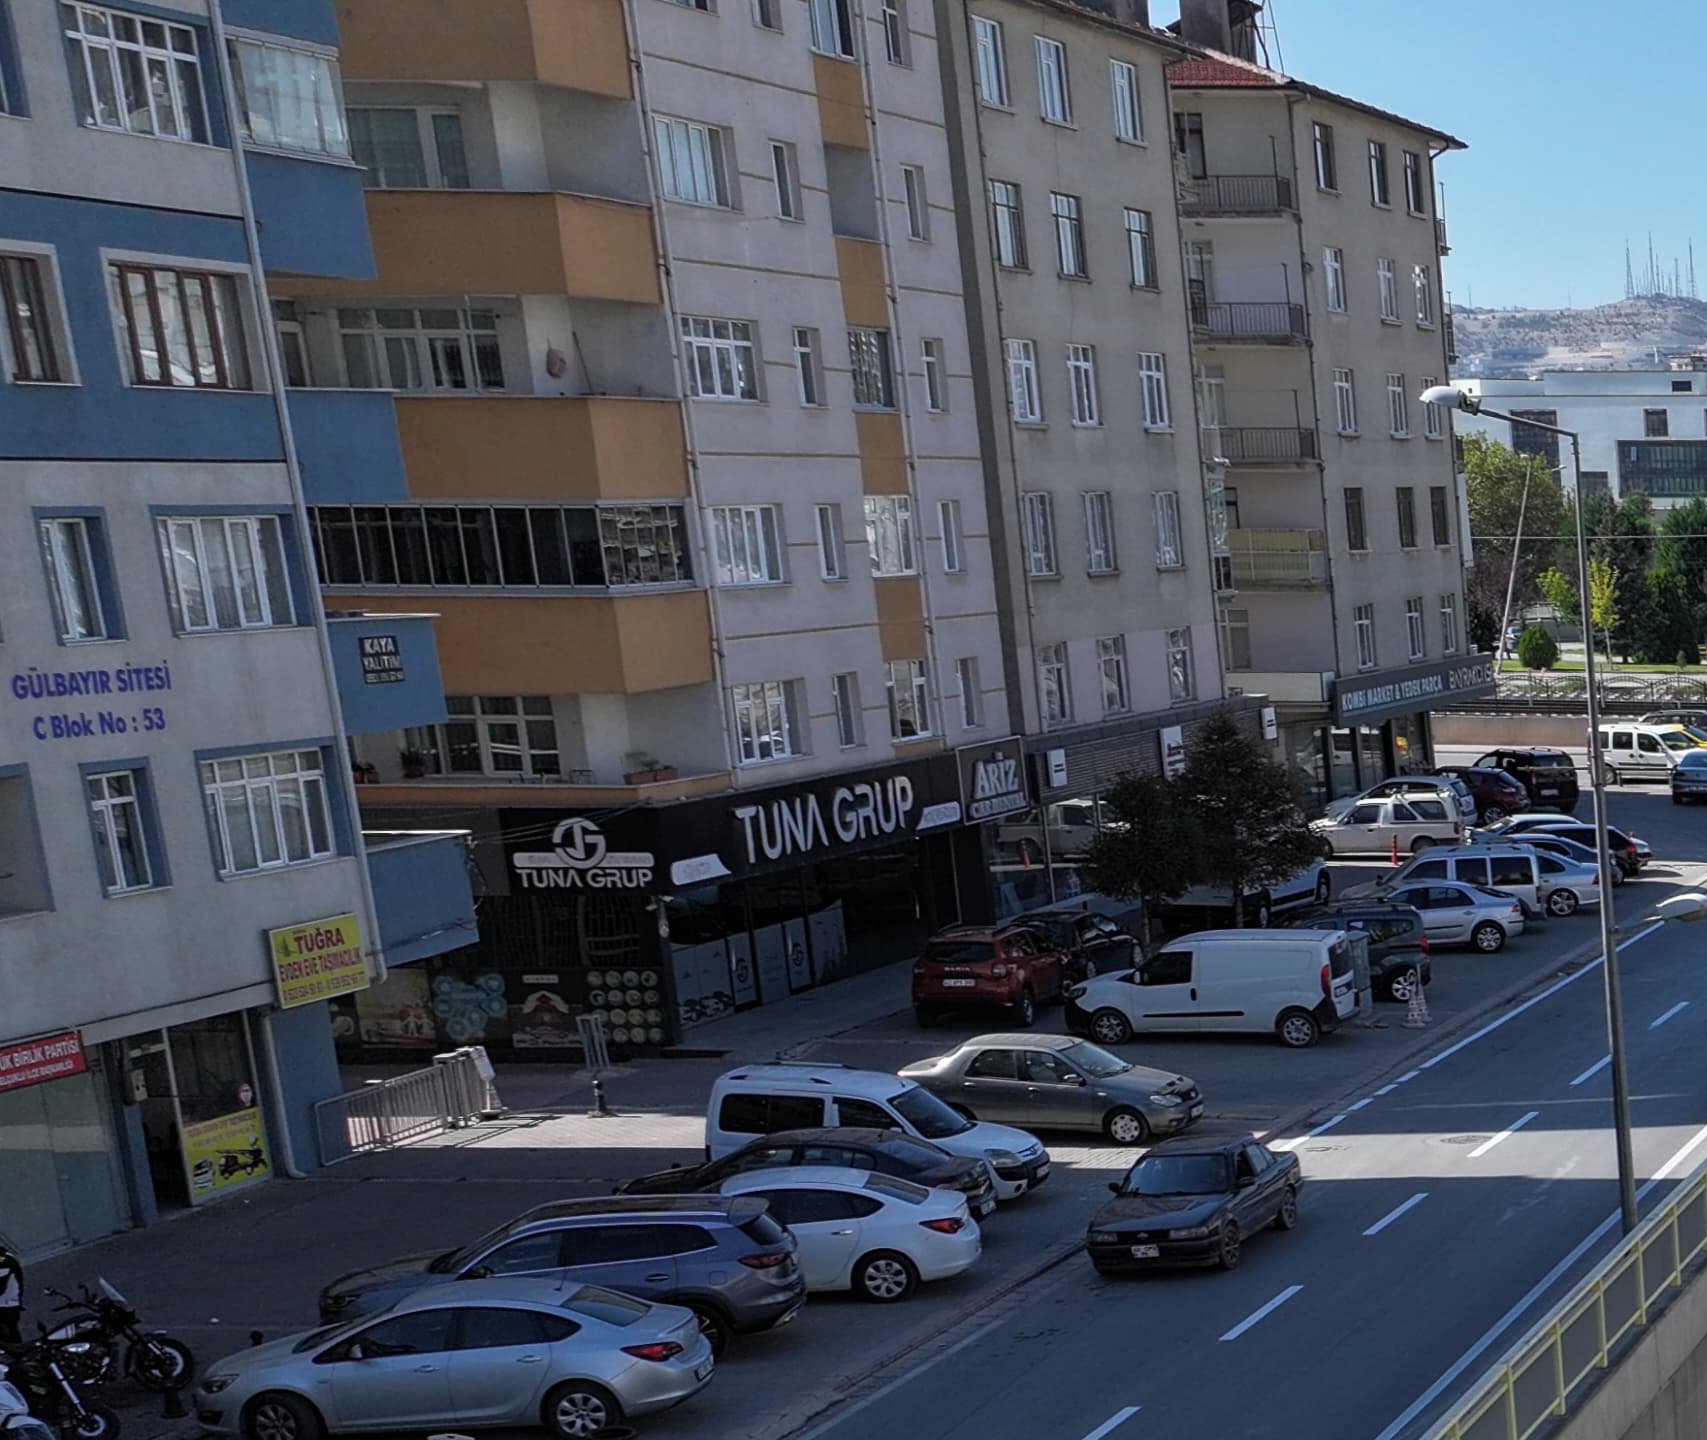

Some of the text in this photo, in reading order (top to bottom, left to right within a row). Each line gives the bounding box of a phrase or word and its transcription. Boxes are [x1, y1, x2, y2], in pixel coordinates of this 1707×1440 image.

[363, 637, 396, 654] KAYA
[12, 659, 172, 699] GÜLBAYIR SİTESİ
[1367, 684, 1393, 705] MARKET
[1402, 678, 1422, 698] YEDEK
[33, 716, 47, 740] C
[51, 712, 95, 738] Blok
[99, 711, 127, 735] No
[143, 707, 165, 731] 53
[734, 776, 914, 864] TUNA GRUP
[514, 869, 653, 888] TUNA GRUP
[294, 928, 345, 954] TUĞRA
